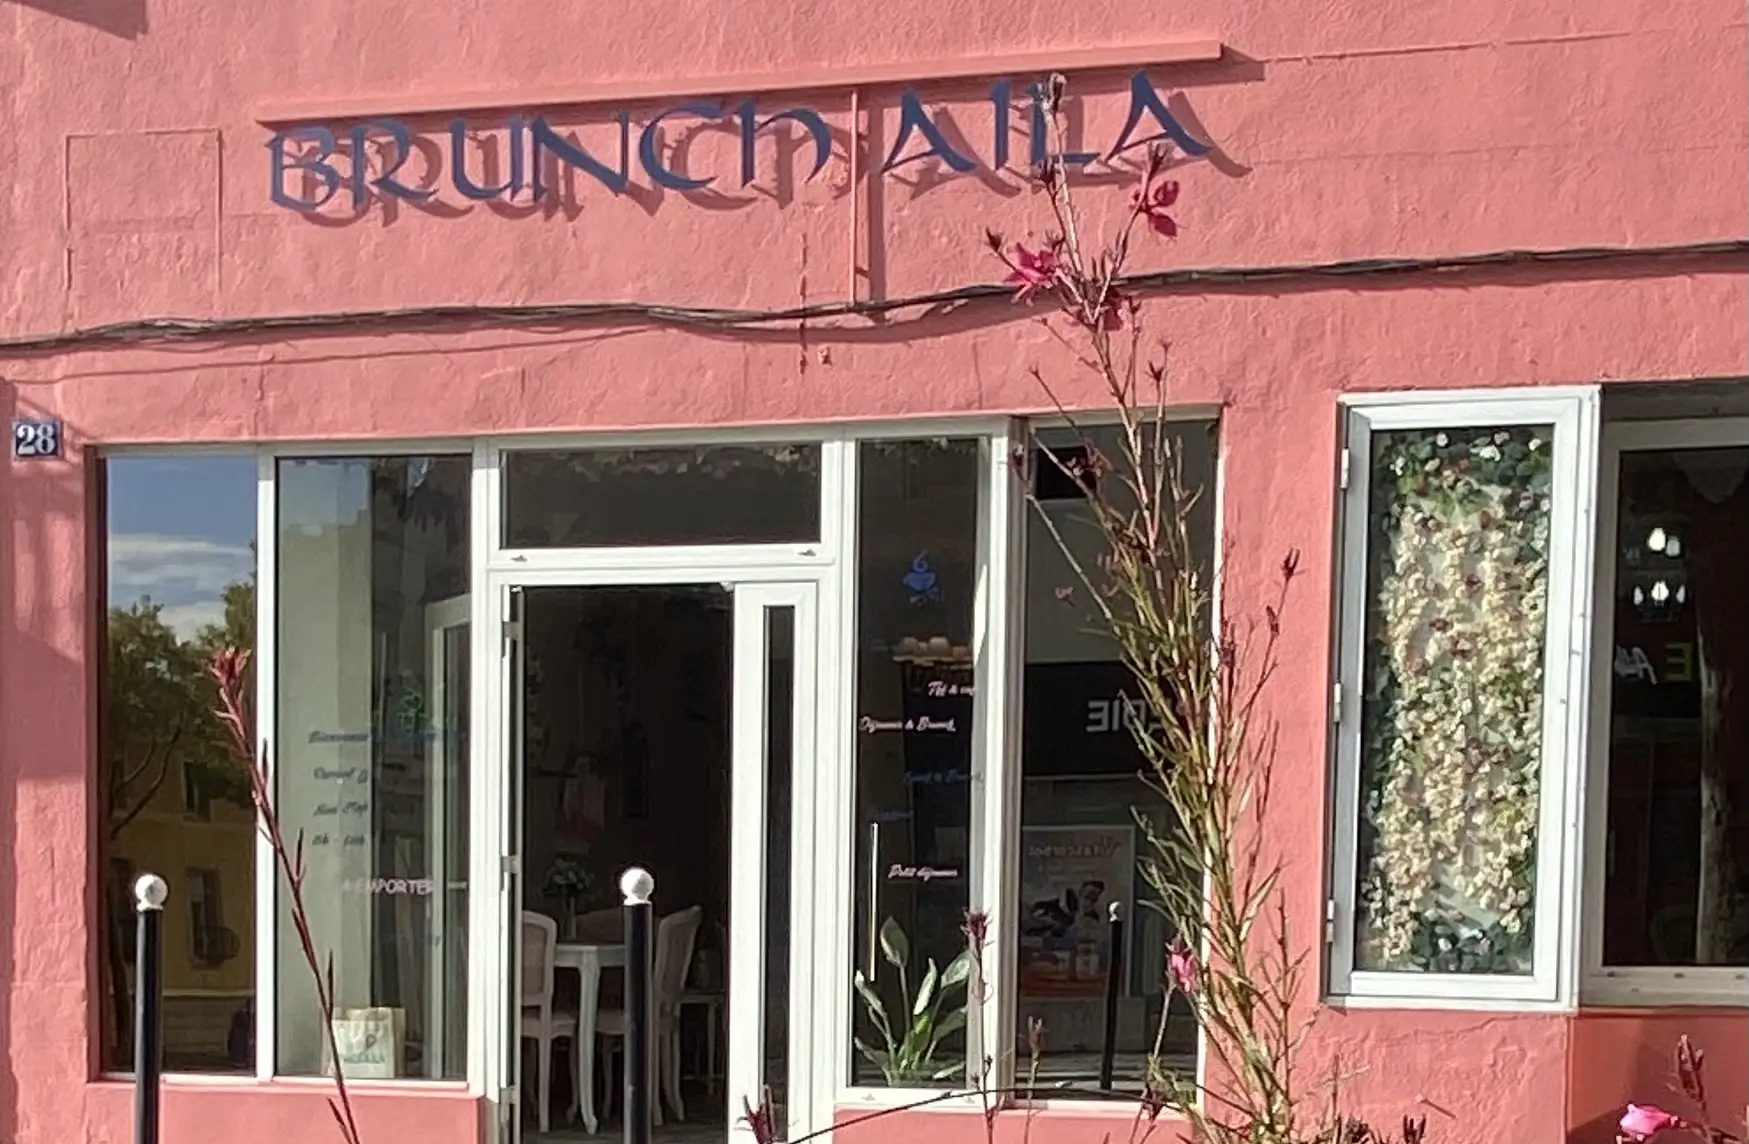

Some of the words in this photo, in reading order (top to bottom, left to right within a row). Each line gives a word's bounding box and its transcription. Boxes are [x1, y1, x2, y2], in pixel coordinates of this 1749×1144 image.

[264, 95, 831, 212] BRUNCH
[881, 70, 1212, 175] AILA
[17, 424, 56, 455] 28
